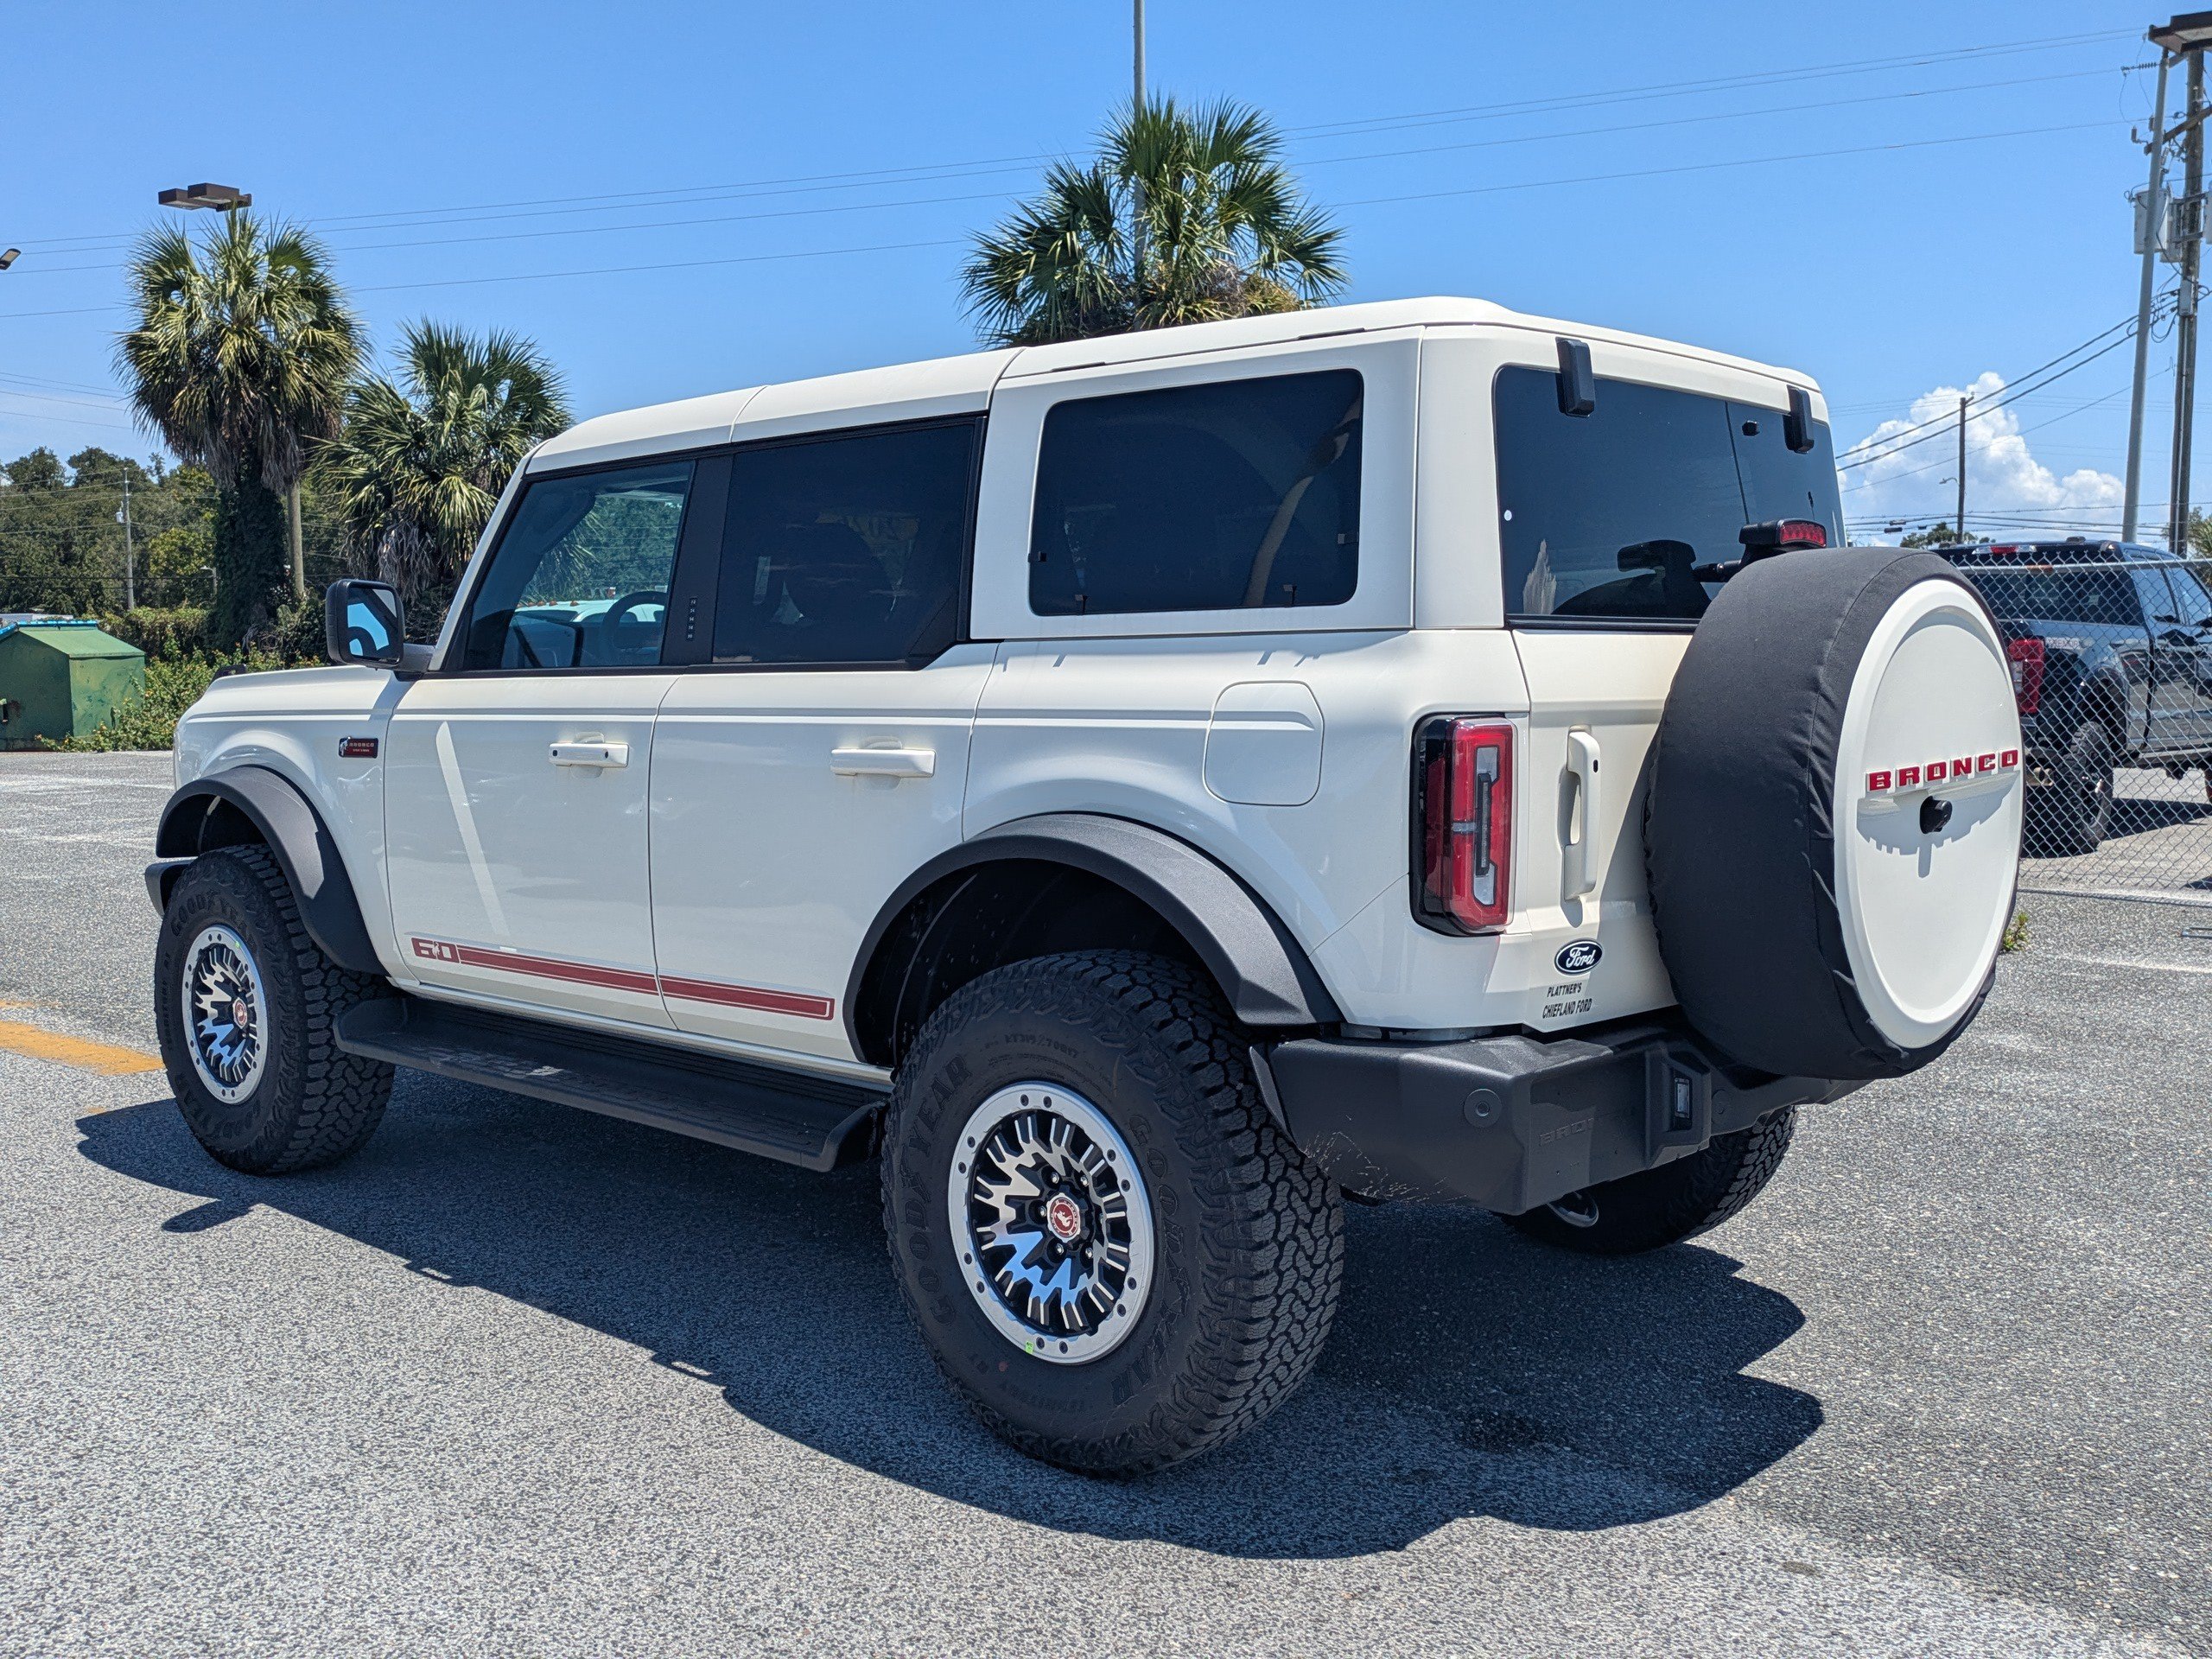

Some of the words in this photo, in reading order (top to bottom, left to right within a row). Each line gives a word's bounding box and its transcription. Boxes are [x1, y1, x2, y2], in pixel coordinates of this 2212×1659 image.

[1867, 749, 2018, 791] BRONCO
[411, 938, 461, 963] 60
[1566, 946, 1597, 969] Ford
[1547, 982, 1582, 998] PLATTNER'S
[1542, 1000, 1576, 1019] CHIEFLAND
[1575, 998, 1592, 1014] FORD
[900, 1054, 973, 1326] GOODYEAR
